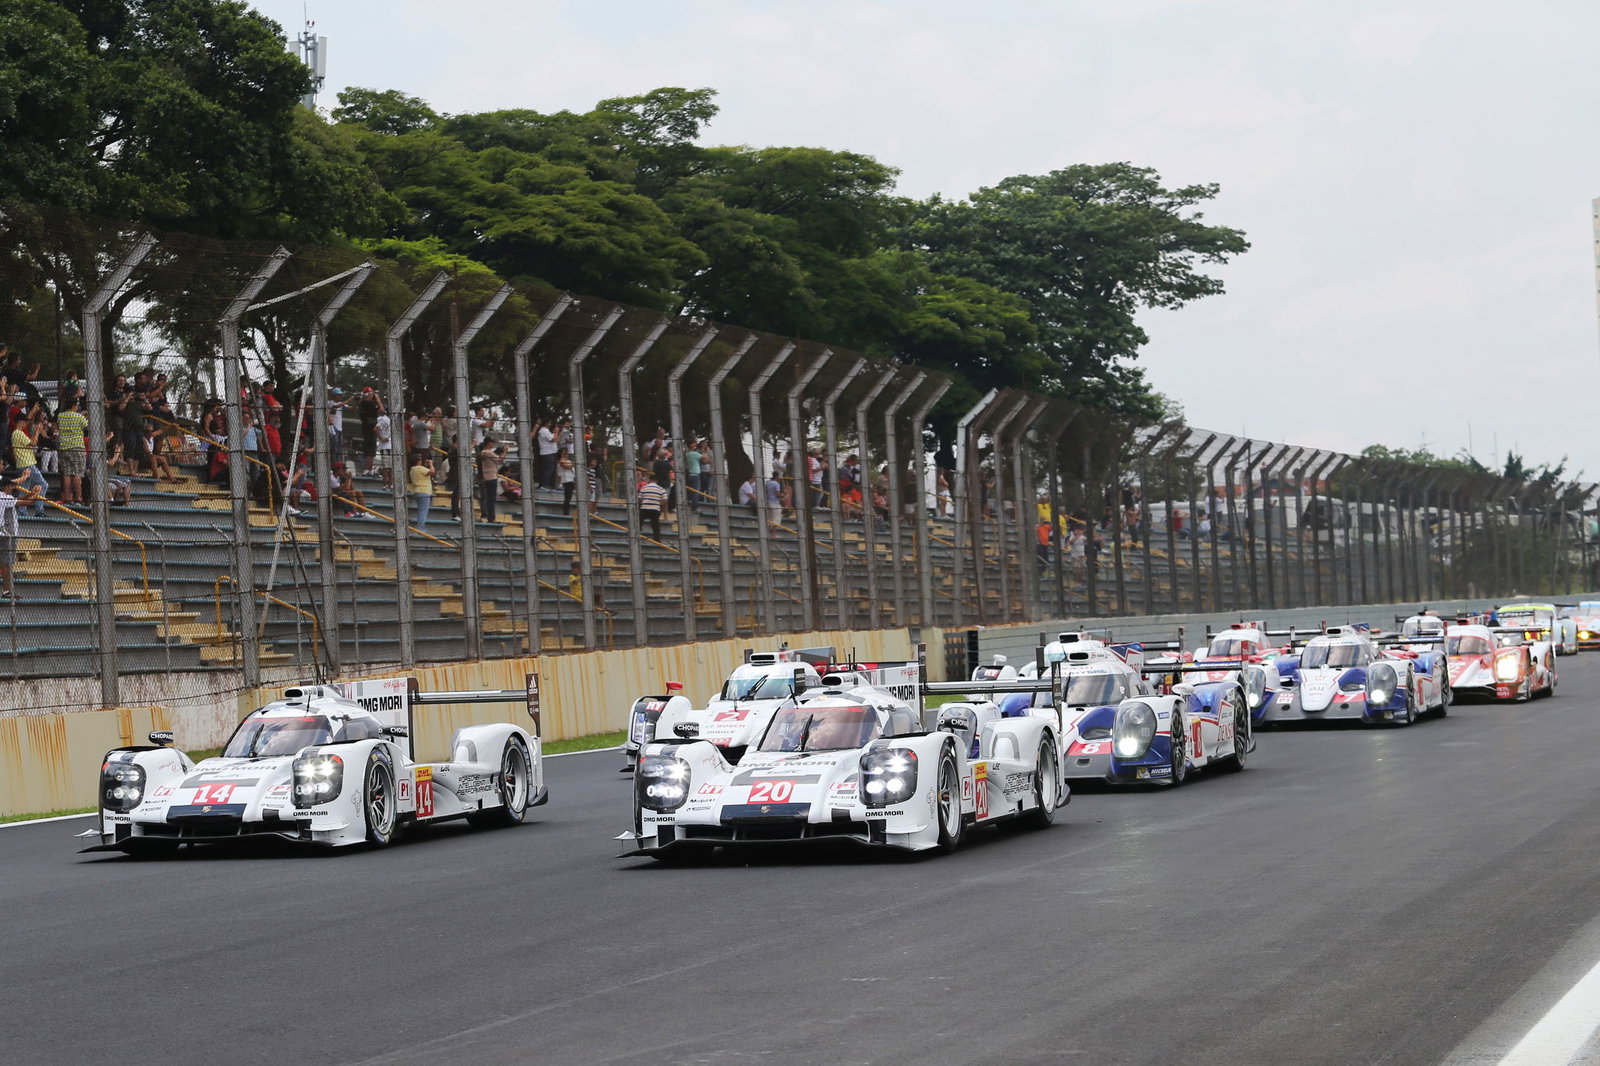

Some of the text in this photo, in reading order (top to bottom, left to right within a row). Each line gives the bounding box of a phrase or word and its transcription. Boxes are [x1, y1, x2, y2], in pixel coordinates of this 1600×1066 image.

[379, 695, 402, 711] MORI
[721, 711, 740, 721] 2
[1081, 742, 1101, 754] 8
[193, 784, 233, 802] 14
[401, 783, 408, 797] P1
[417, 782, 432, 814] 14
[749, 781, 793, 802] 20
[976, 780, 987, 815] 20
